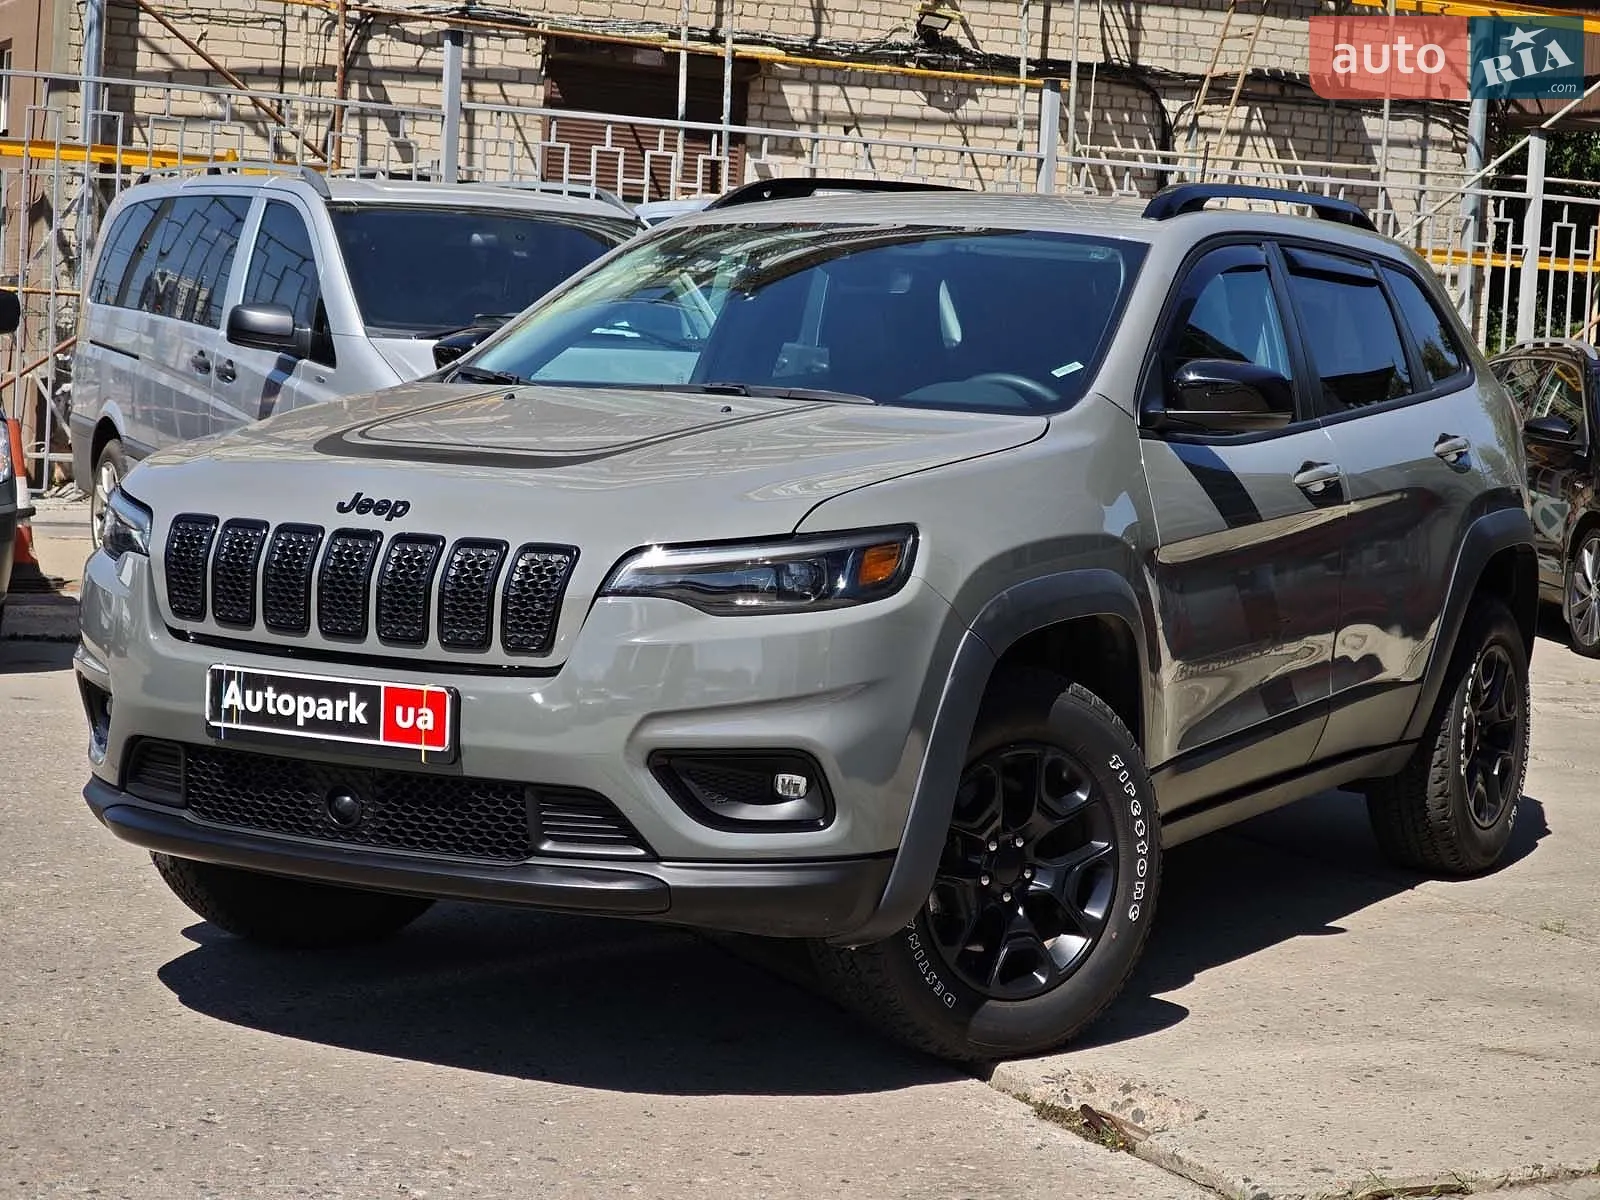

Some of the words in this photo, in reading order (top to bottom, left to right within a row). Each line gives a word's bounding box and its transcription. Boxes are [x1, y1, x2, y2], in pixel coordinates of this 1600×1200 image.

[336, 492, 411, 521] Jeep
[222, 680, 369, 726] Autopark
[395, 704, 435, 731] ua
